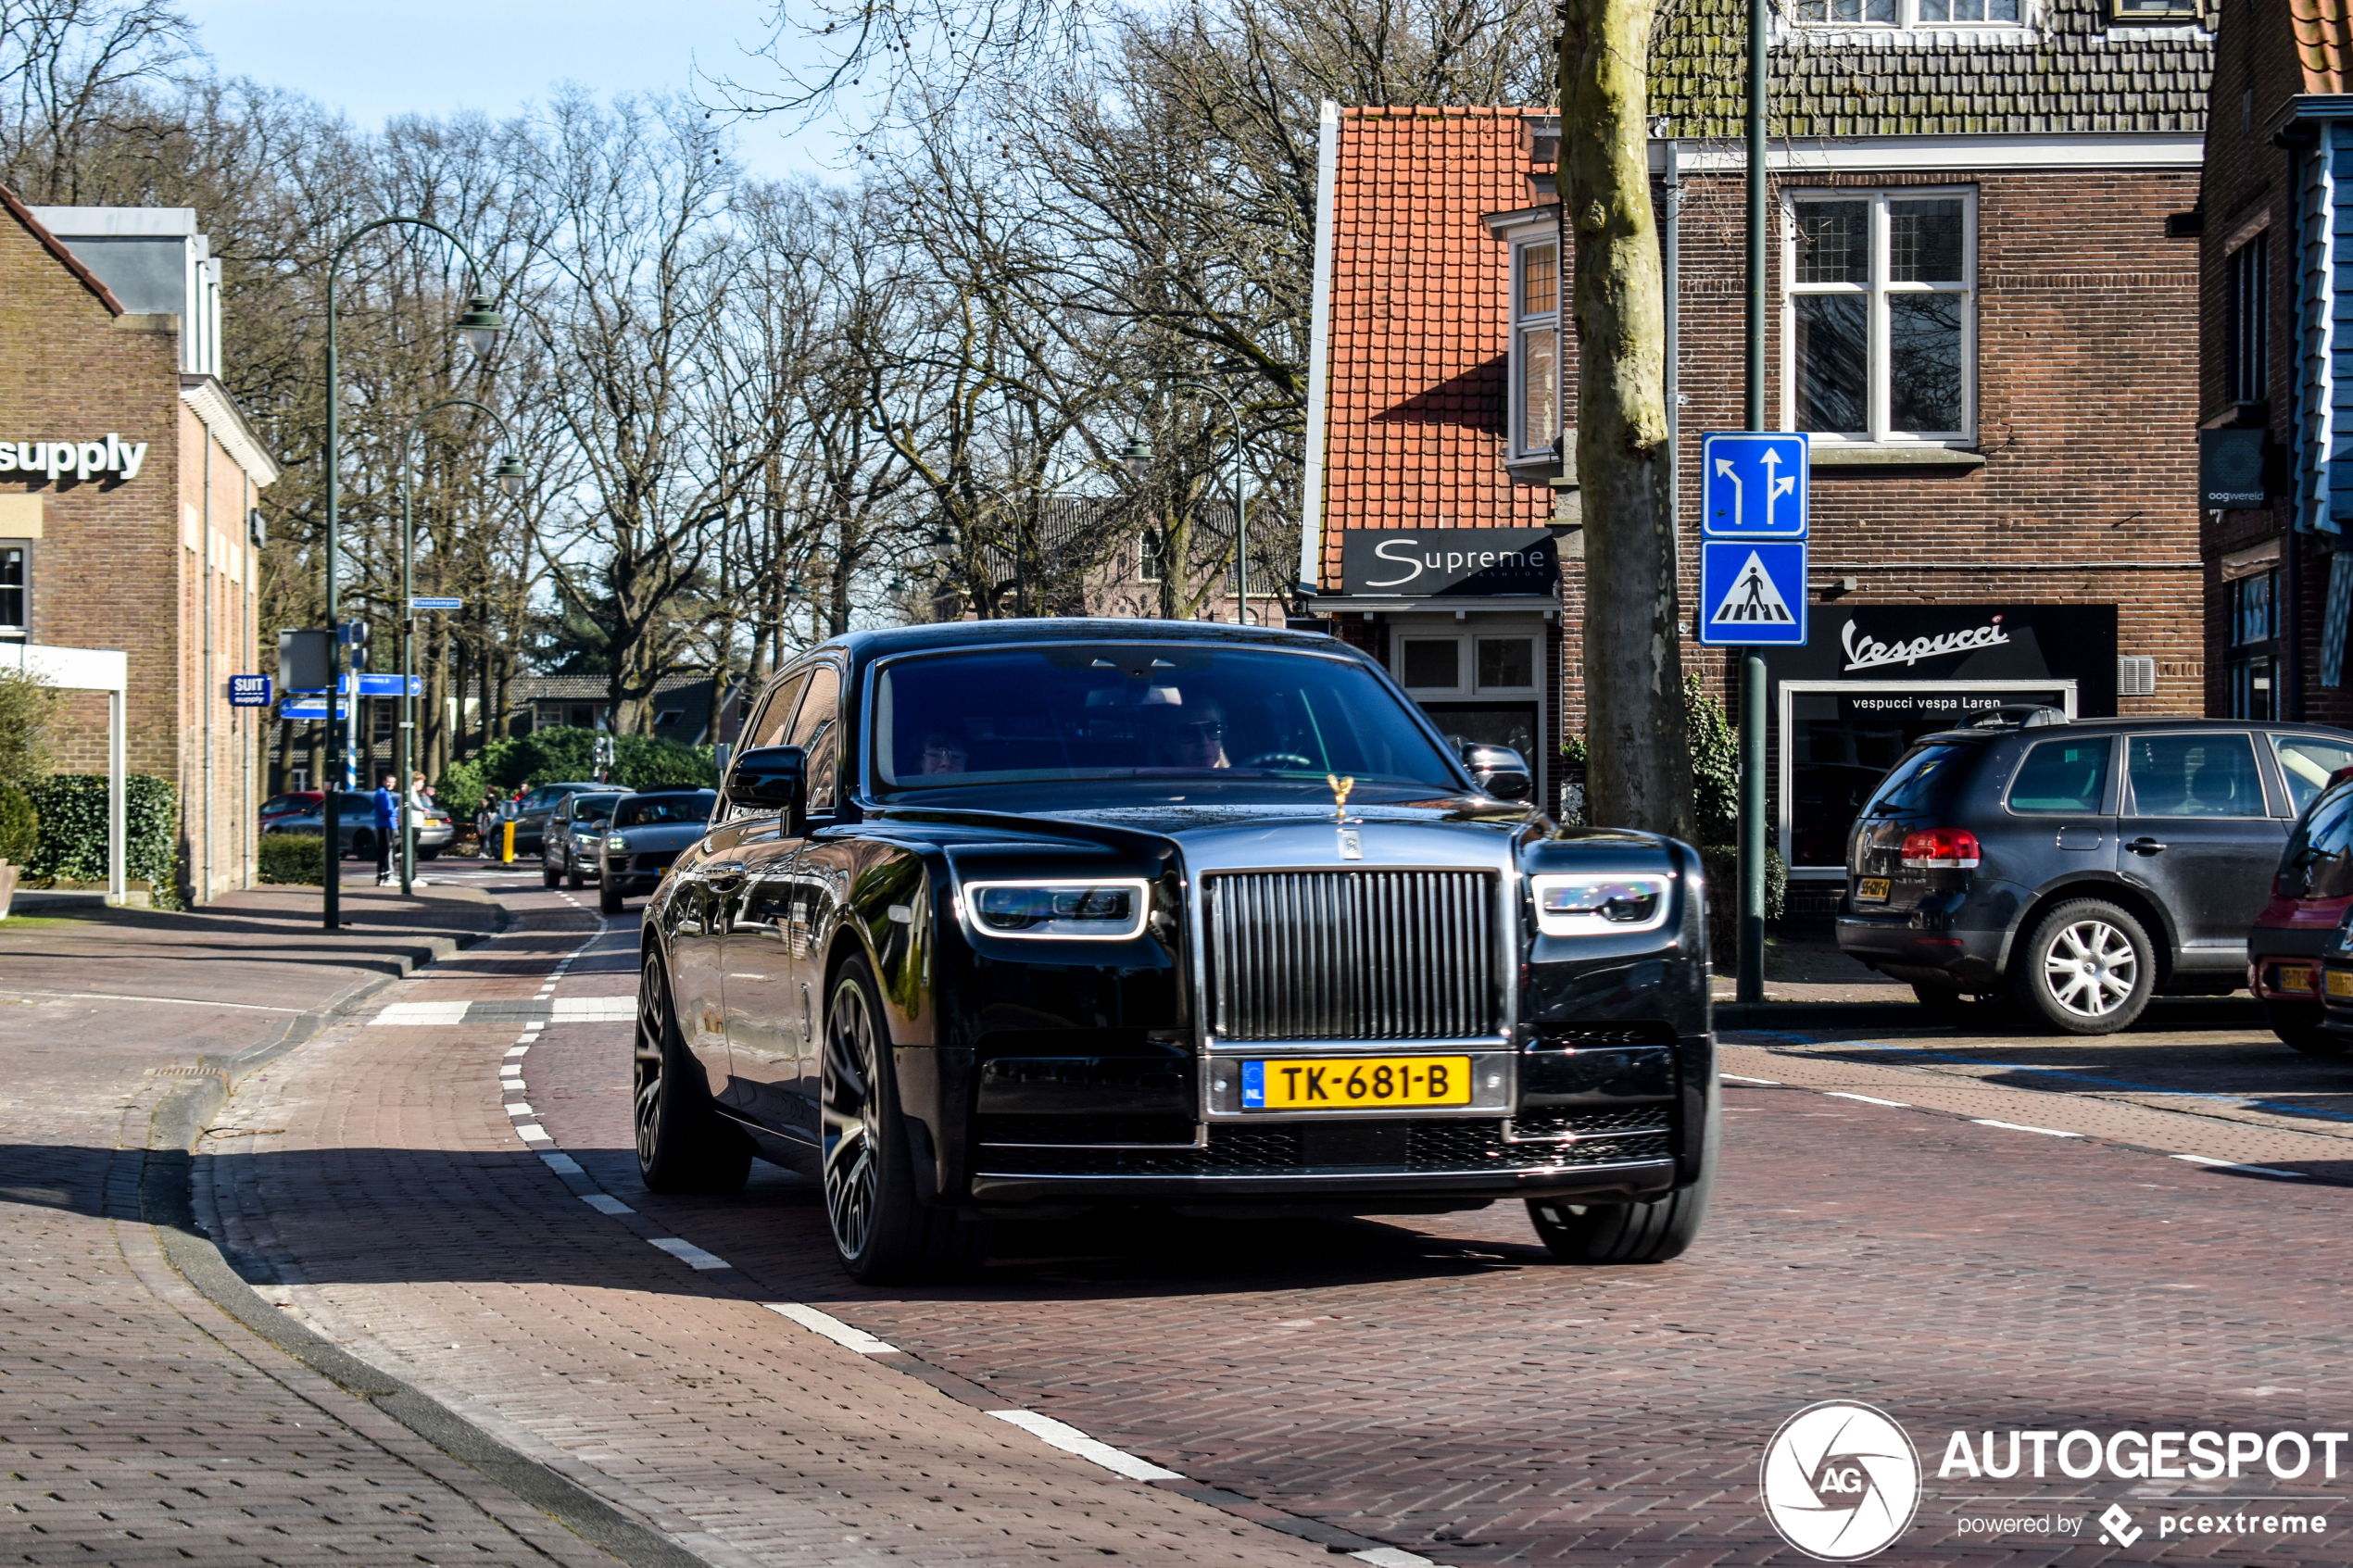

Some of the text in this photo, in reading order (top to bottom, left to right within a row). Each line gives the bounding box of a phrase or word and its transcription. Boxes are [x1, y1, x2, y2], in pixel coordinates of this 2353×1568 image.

[0, 433, 148, 480] supply
[2208, 492, 2264, 502] oogwereld
[1365, 539, 1544, 587] Supreme
[1842, 615, 2009, 670] Vespucci
[234, 678, 265, 692] SUIT
[234, 696, 265, 704] supply
[1853, 696, 2001, 710] vespucci vespa Laren
[1280, 1064, 1449, 1101] TK-681-B
